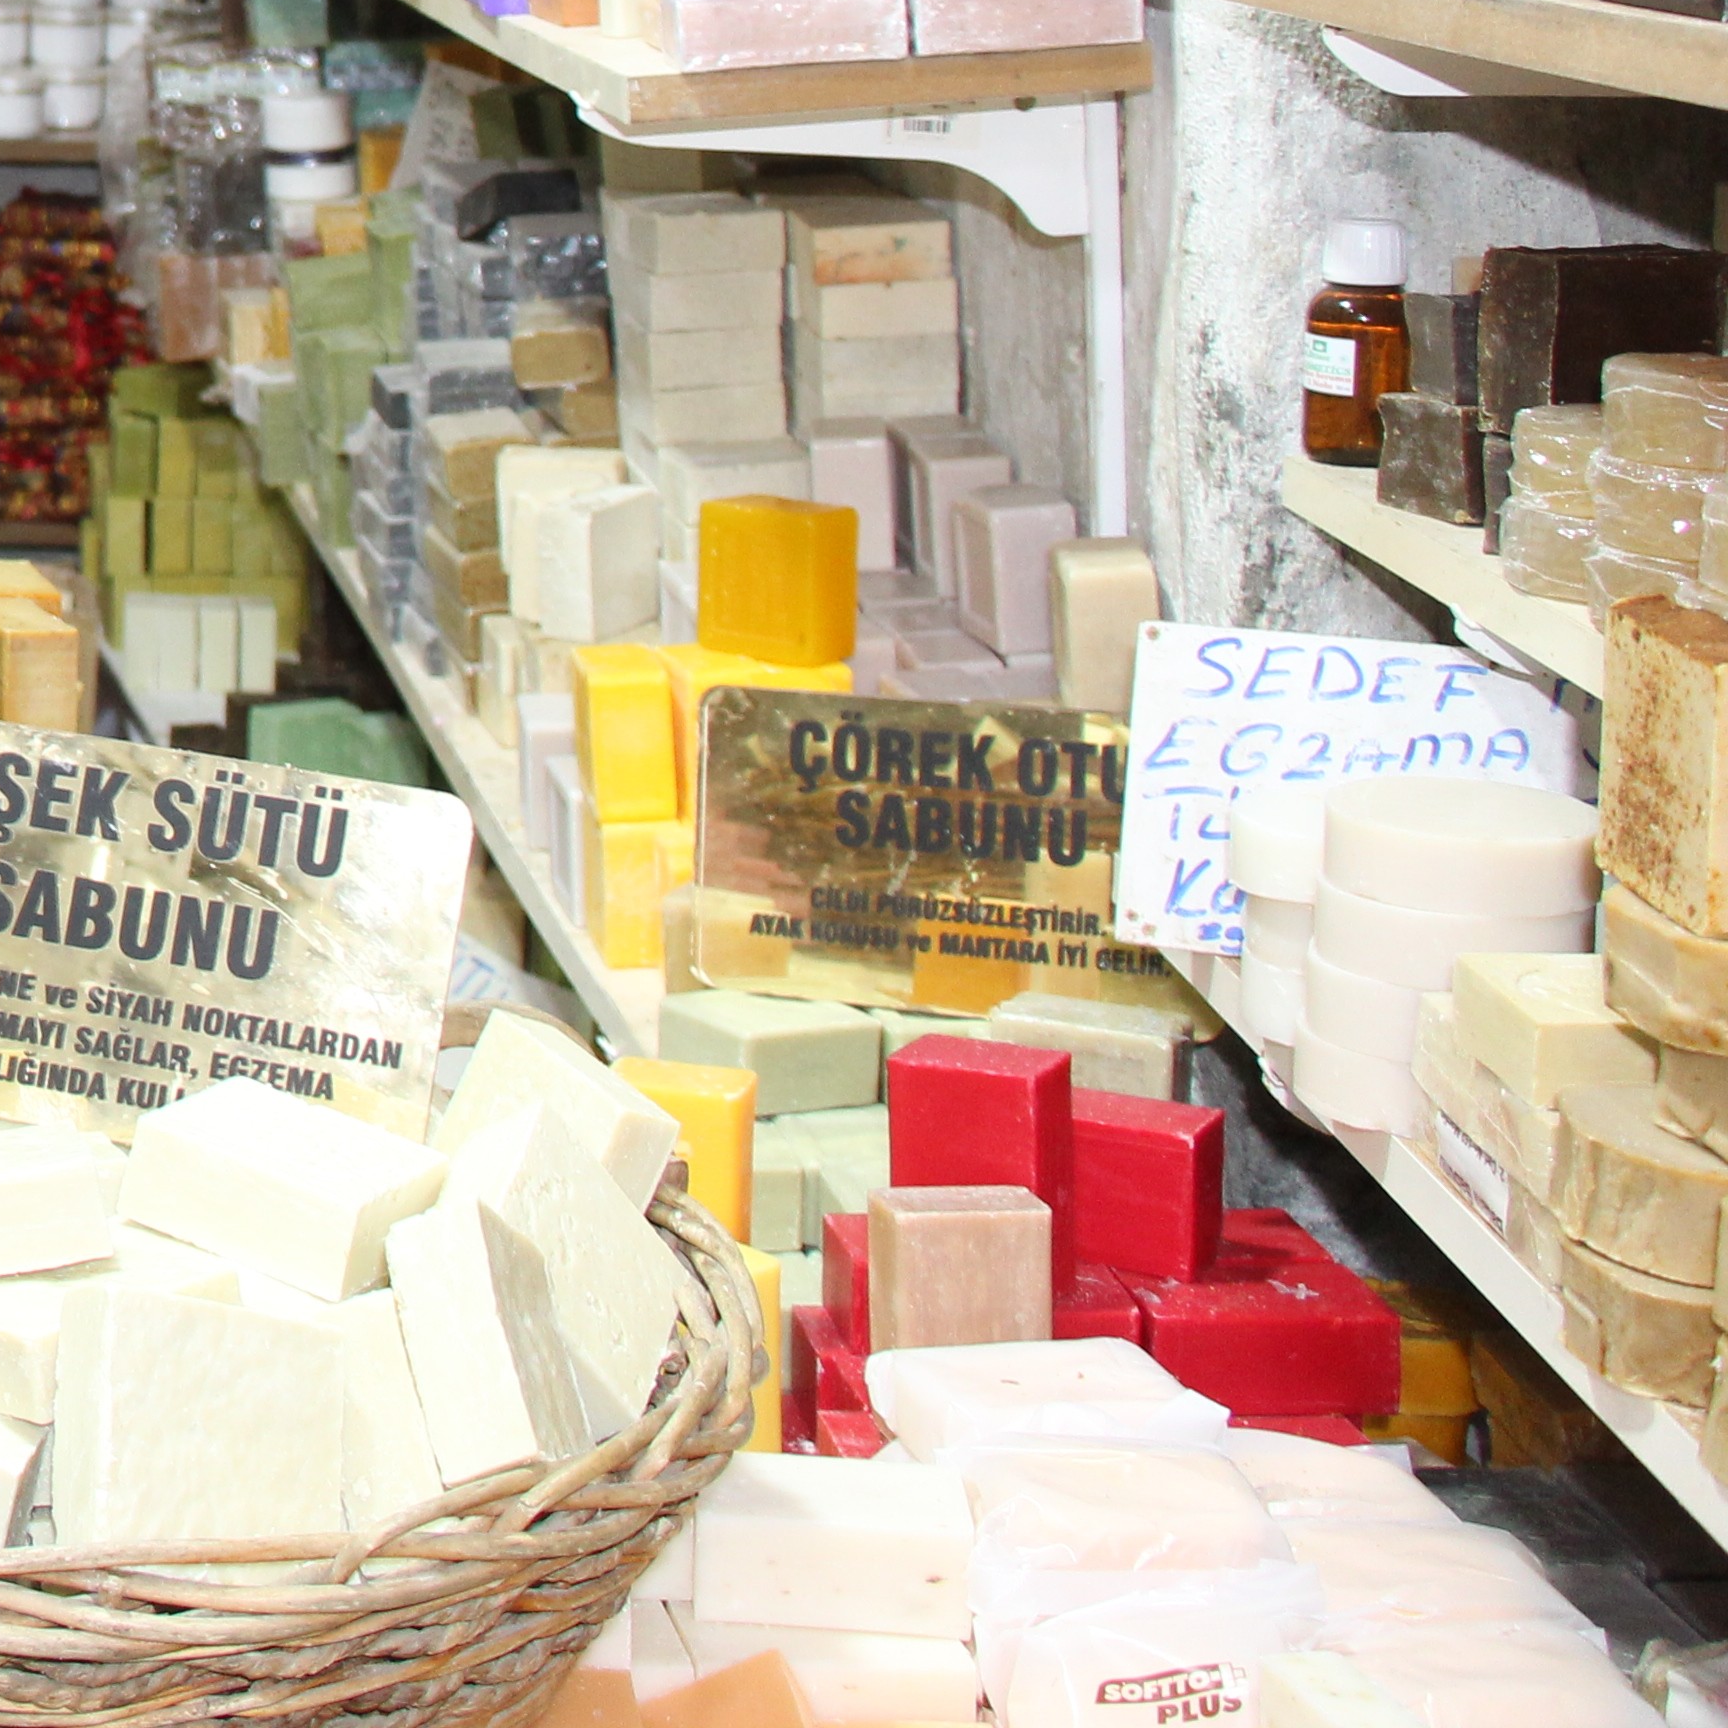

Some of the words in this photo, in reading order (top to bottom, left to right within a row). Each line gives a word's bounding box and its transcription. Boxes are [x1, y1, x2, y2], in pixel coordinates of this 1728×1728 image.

[1183, 636, 1488, 713] SEDEF
[789, 710, 996, 794] ÇÖREK
[146, 769, 350, 879] SÜTÜ
[834, 790, 1088, 868] SABUNU
[748, 913, 804, 940] AYAK
[810, 919, 900, 951] KOKUSU
[906, 935, 932, 953] ve
[939, 932, 1050, 966] MANTARA
[1057, 938, 1088, 969] İYİ
[44, 982, 77, 1009] ve
[85, 982, 174, 1028] SİYAH
[181, 1003, 403, 1069] NOKTALARDAN
[73, 1022, 198, 1079] SAĞLAR,
[1103, 1669, 1212, 1703] SOFTTO
[1156, 1692, 1243, 1725] PLUS
